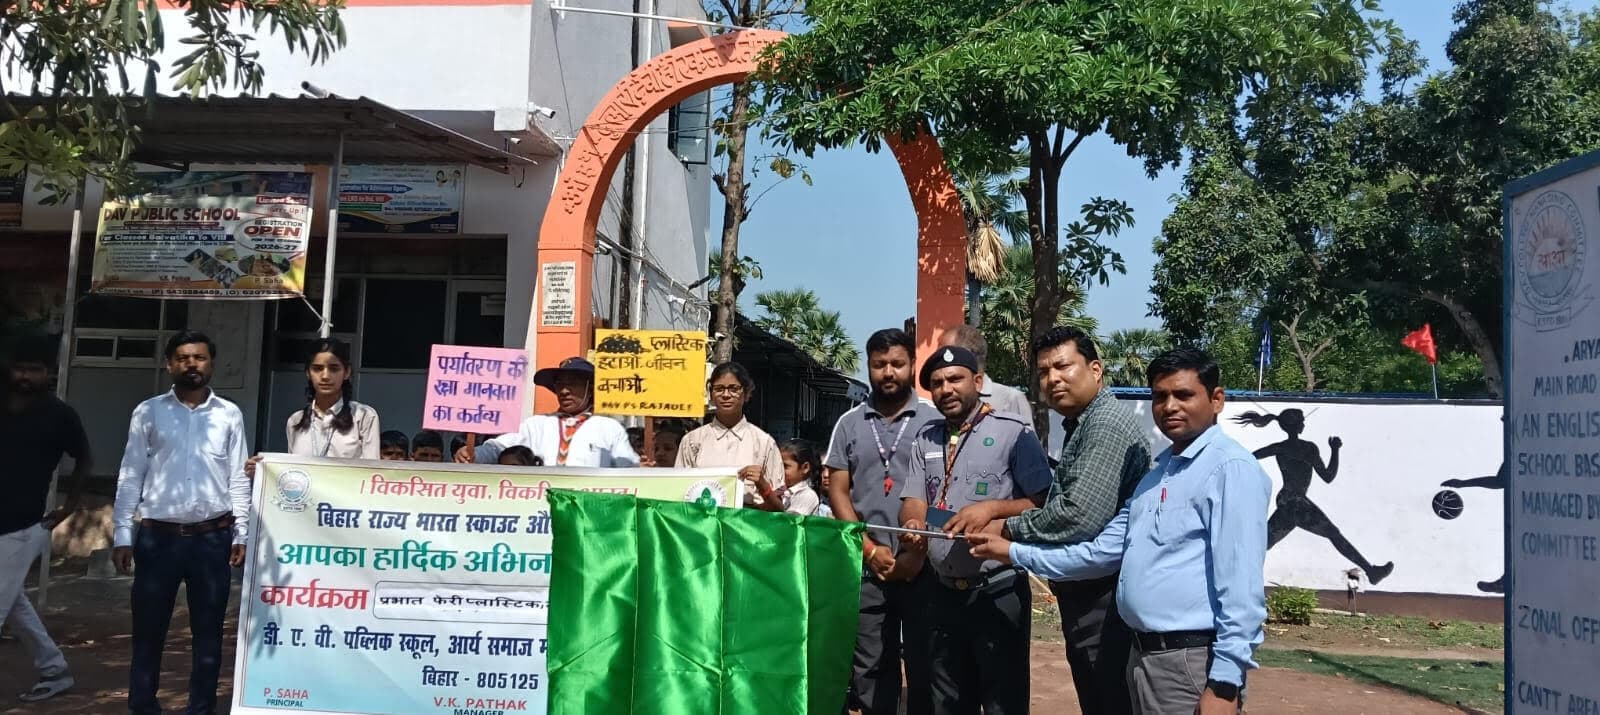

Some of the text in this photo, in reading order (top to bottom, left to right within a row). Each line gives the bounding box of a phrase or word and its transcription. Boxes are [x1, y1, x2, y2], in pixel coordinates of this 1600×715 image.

[103, 207, 241, 221] DAV PUBLIC SCHOOL
[254, 219, 303, 228] REGISTRATION
[243, 225, 302, 237] OPEN
[254, 243, 298, 251] 2026-27
[650, 334, 705, 352] प्लास्टिक
[437, 352, 529, 380] पर्यावरण की
[646, 354, 687, 371] जीवन
[434, 379, 459, 397] रक्षा
[1533, 373, 1597, 397] MAIN ROAD
[433, 404, 502, 426] का कर्तव्य
[1518, 453, 1570, 477] SCHOOL
[370, 474, 448, 498] विकसित
[1521, 490, 1583, 519] MANAGED
[316, 502, 551, 535] बिहार राज्य भारत स्काउट औ
[277, 543, 367, 569] आपका
[373, 539, 458, 572] हार्दिक
[1521, 531, 1597, 561] COMMITTEE
[260, 578, 370, 610] कार्यक्रम
[379, 596, 424, 606] प्रभात
[433, 594, 463, 606] फेरी
[1518, 605, 1567, 639] ZONAL
[263, 621, 283, 647] डी.
[291, 628, 306, 648] ए.
[315, 624, 336, 649] वी.
[343, 626, 395, 652] पब्लिक
[448, 630, 482, 655] आर्य
[487, 636, 534, 657] समाज
[421, 665, 459, 687] बिहार
[476, 672, 539, 690] 805125
[263, 687, 309, 700] P. SAHA
[266, 699, 304, 708] PRINCIPAL
[433, 696, 528, 711] V.K. PATHAK
[1518, 681, 1562, 713] CANTT
